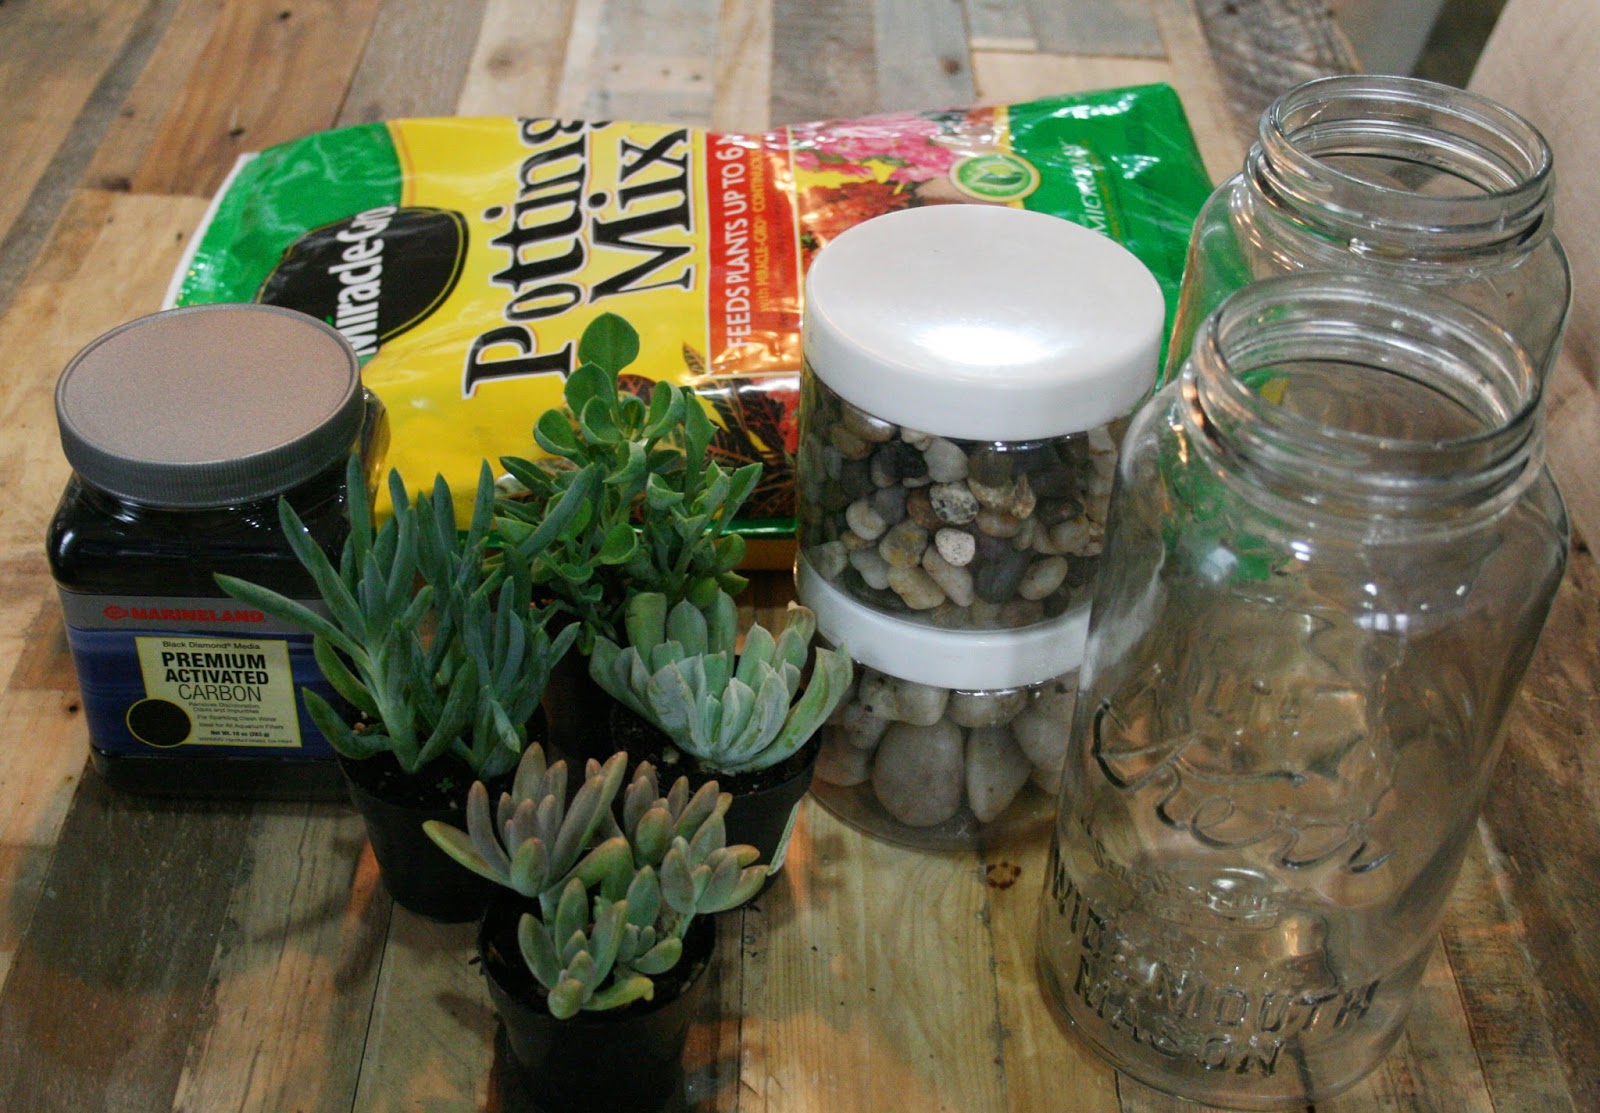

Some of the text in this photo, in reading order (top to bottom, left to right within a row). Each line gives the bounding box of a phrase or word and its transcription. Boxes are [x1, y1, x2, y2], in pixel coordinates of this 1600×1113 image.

[715, 146, 745, 161] 6
[721, 163, 746, 189] TO
[722, 190, 749, 217] UP
[588, 128, 692, 303] Mix
[724, 218, 751, 285] PLANTS
[725, 286, 752, 348] FEEDS
[130, 607, 265, 623] MARINELAND
[162, 640, 187, 649] Black
[233, 642, 261, 650] Media
[161, 652, 266, 669] PREMIUM
[165, 669, 269, 685] ACTIVATED
[178, 684, 262, 702] CARBON
